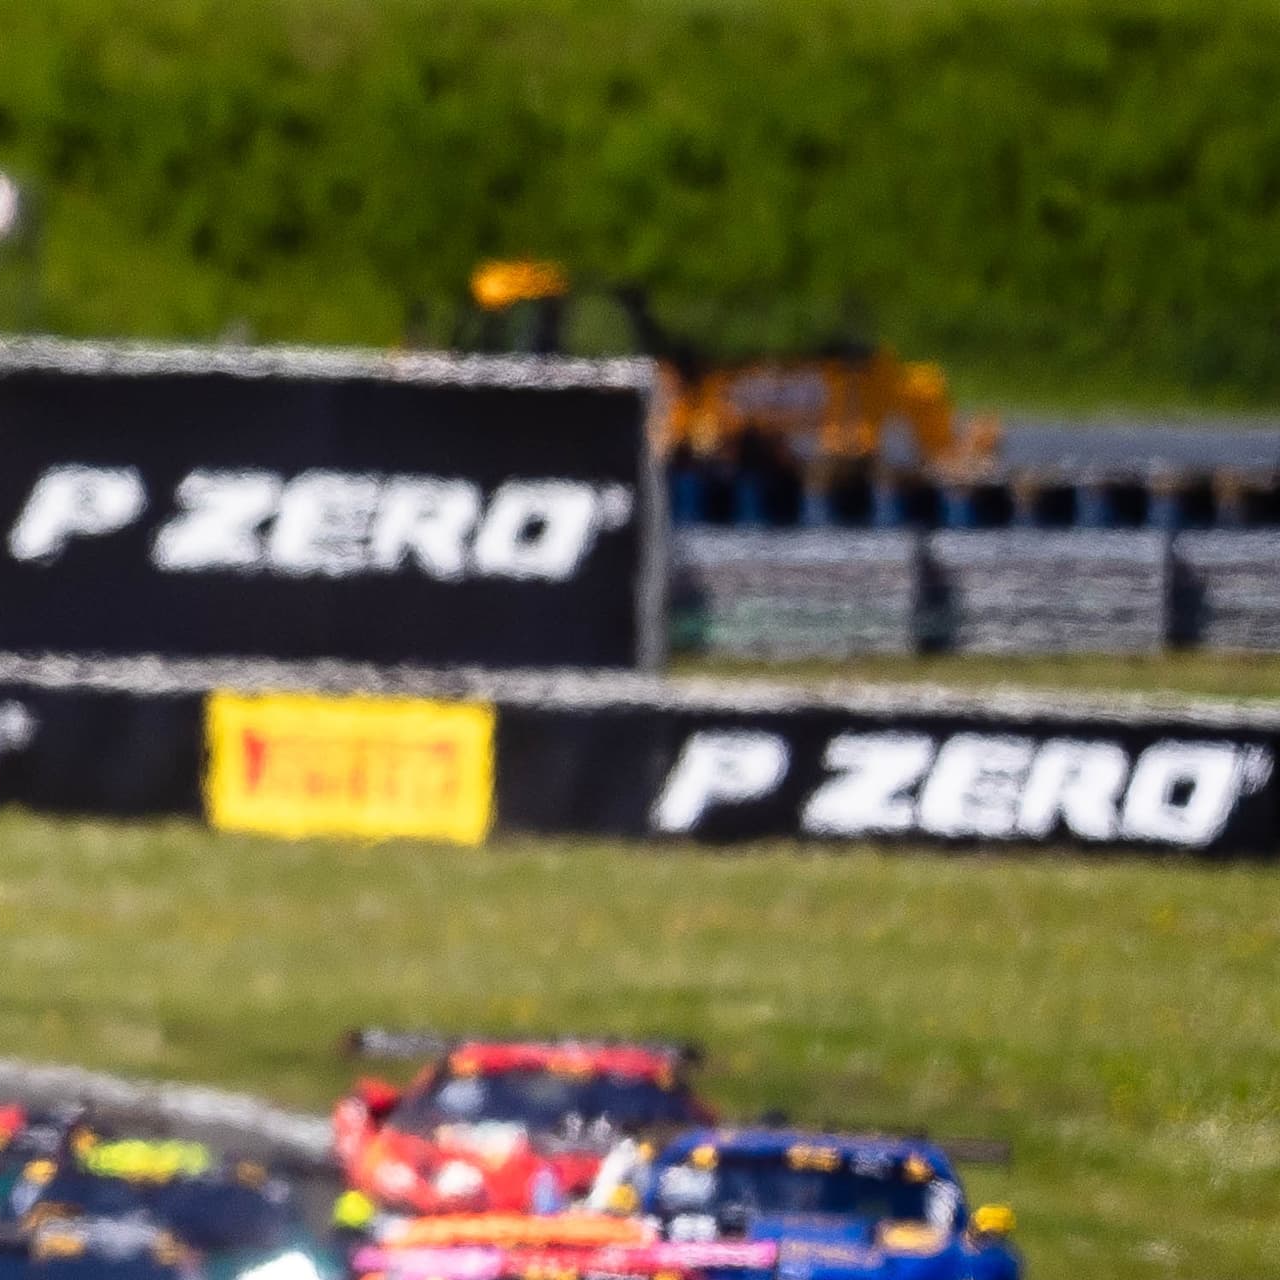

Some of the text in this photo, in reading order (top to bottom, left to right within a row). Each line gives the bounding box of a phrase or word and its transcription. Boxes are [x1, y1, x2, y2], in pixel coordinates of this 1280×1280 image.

[8, 464, 600, 580] P ZERO
[652, 730, 1246, 848] P ZERO
